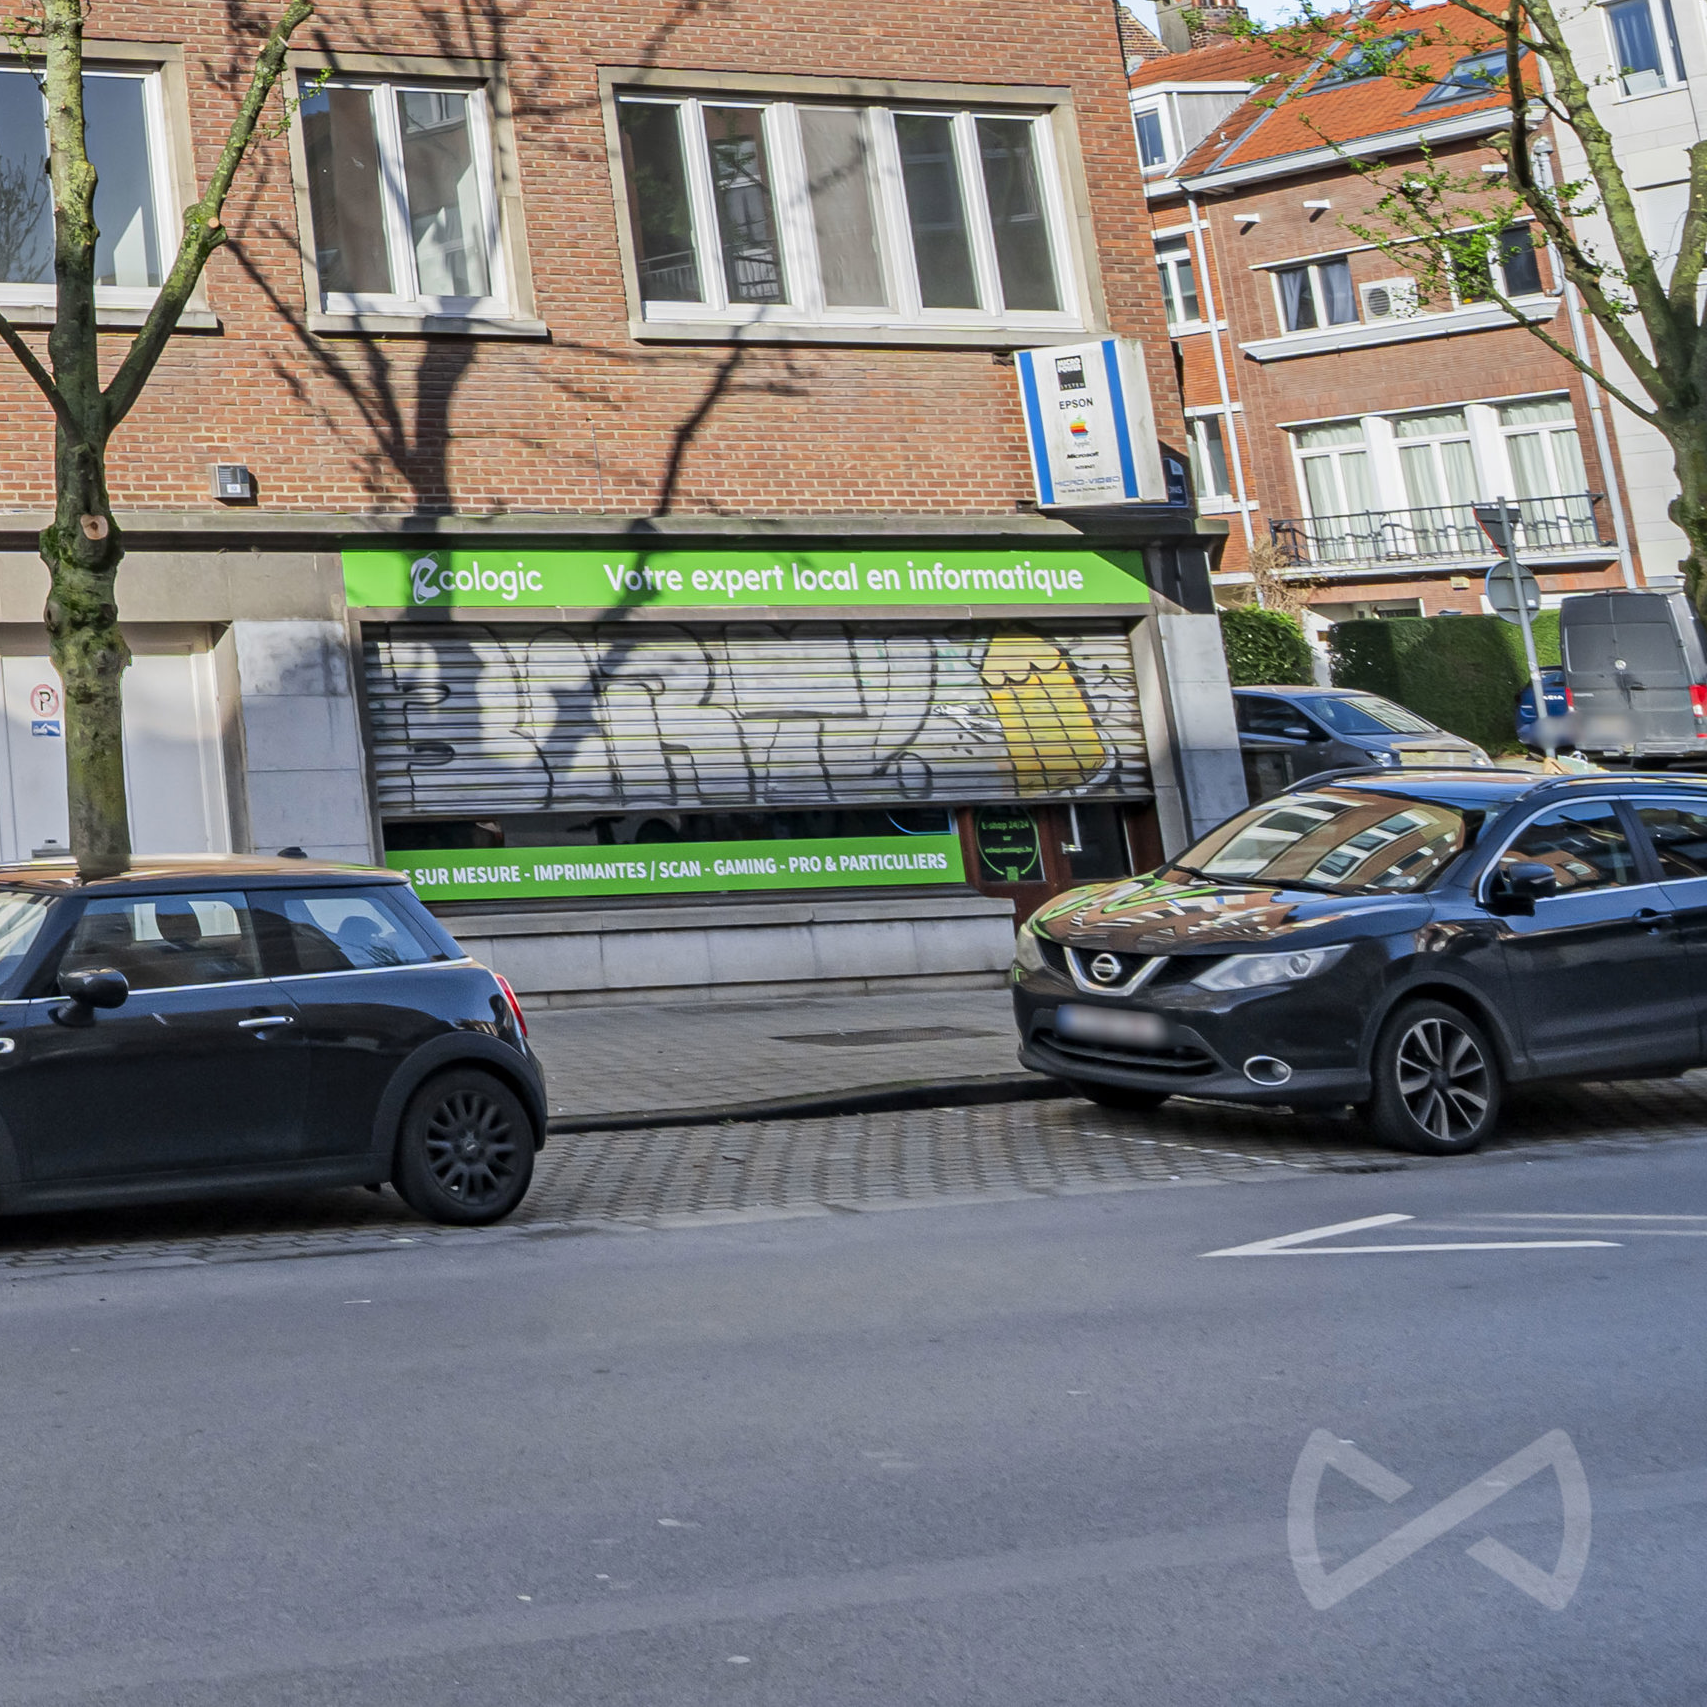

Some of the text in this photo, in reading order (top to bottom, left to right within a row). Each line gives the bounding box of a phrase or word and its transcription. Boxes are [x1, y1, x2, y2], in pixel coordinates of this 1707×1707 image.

[1060, 382, 1085, 390] SYSTEM
[1059, 397, 1094, 410] EPSON
[1066, 451, 1099, 459] Microsoft
[603, 560, 1085, 598] Votre expert local en informatique
[415, 868, 449, 886] SUR
[453, 865, 521, 884] MESURE
[533, 861, 647, 882] IMPRIMANTES
[659, 860, 702, 879] SCAN
[713, 856, 777, 876] GAMING
[789, 855, 822, 873] PRO
[824, 855, 837, 872] &
[839, 852, 948, 871] PARTICULIERS
